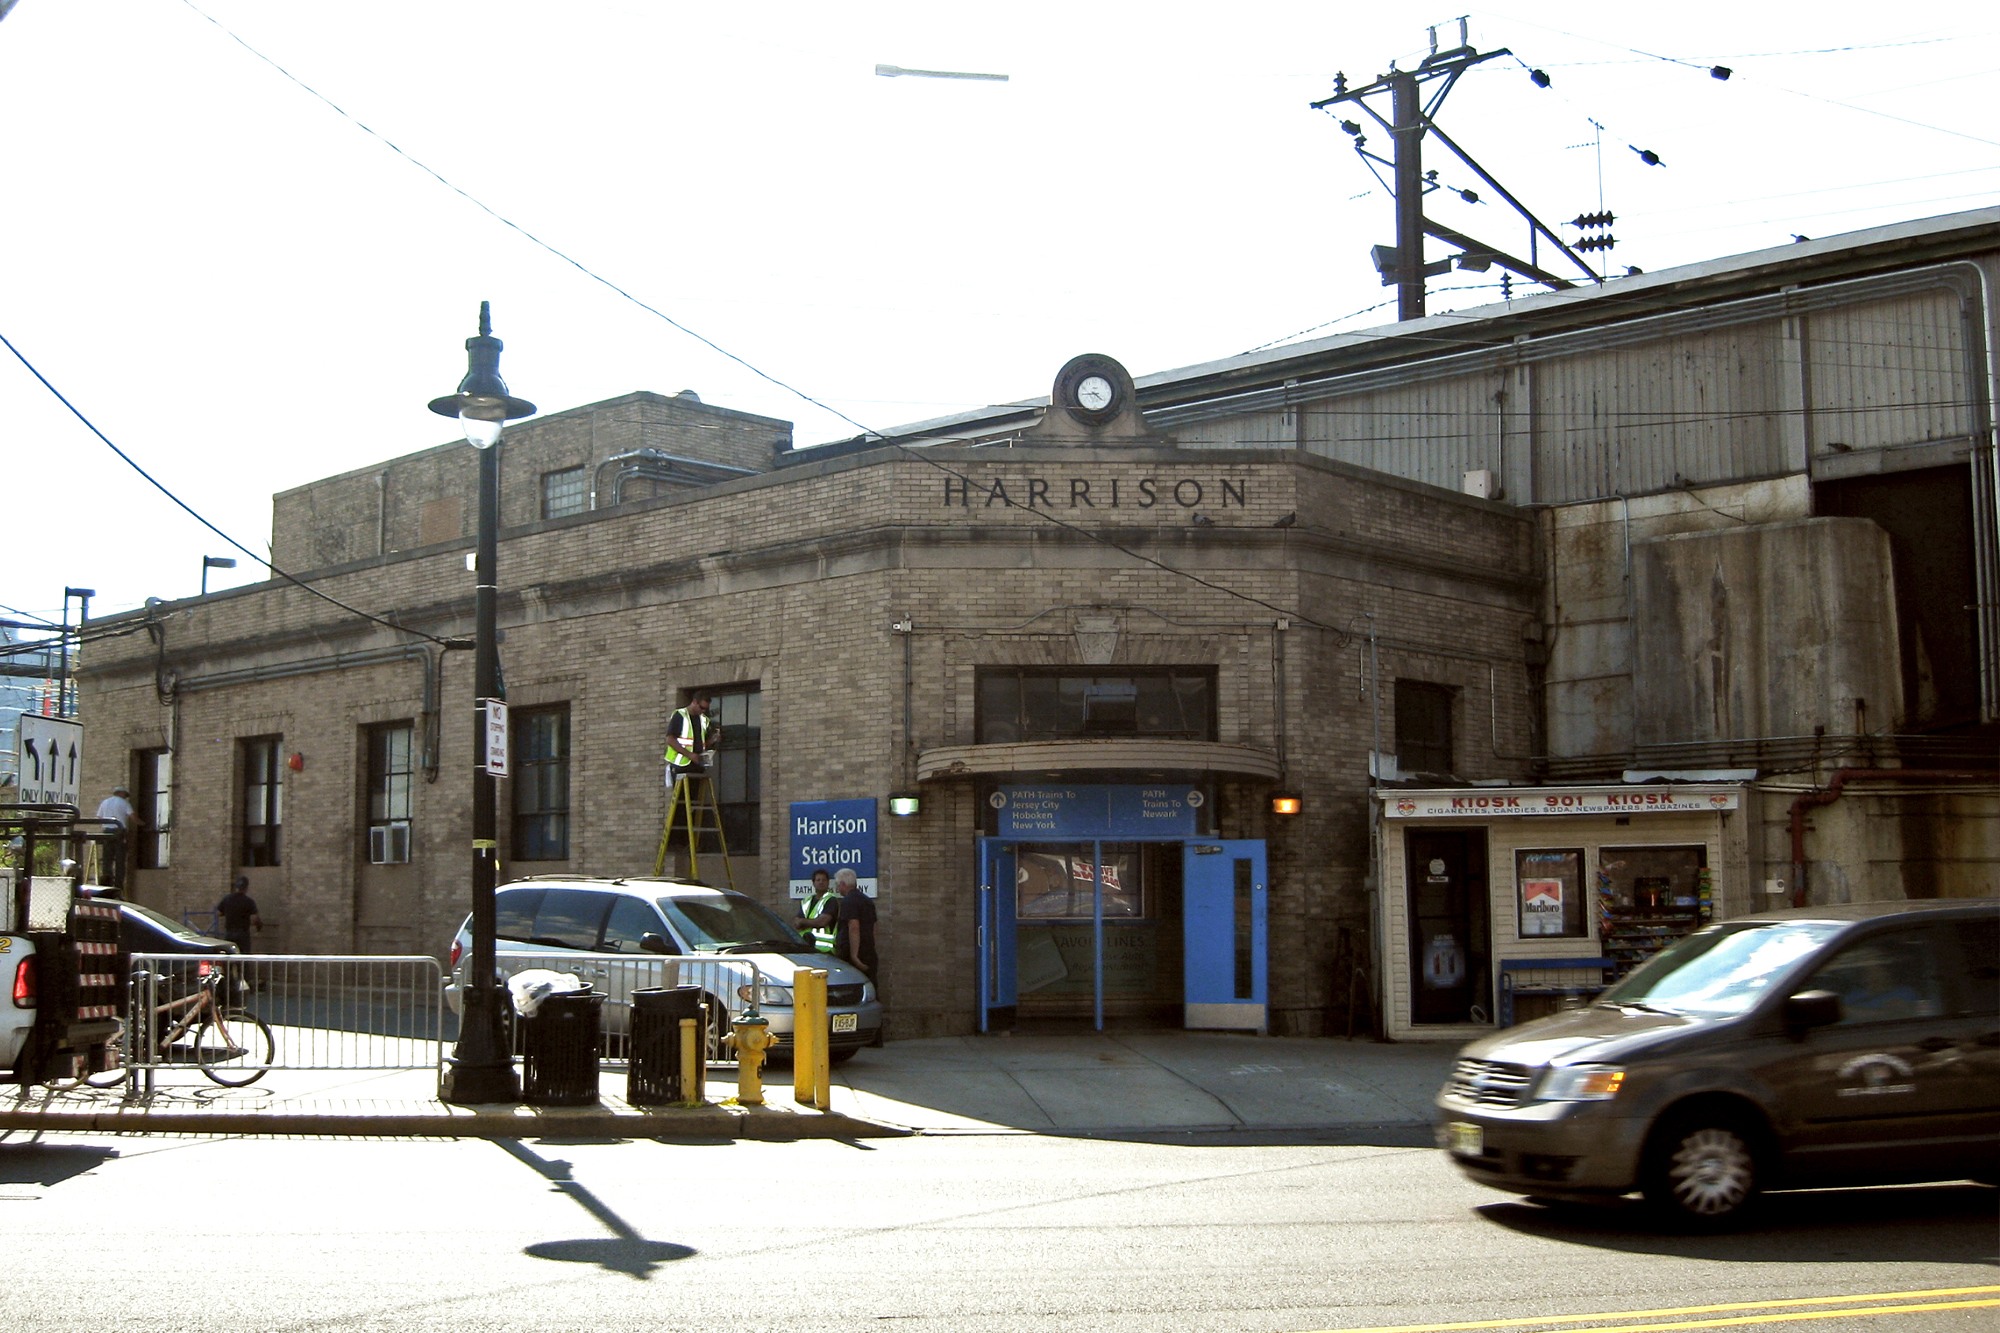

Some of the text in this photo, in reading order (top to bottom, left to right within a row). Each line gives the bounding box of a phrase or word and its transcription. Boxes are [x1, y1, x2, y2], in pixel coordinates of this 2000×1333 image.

[943, 477, 1246, 508] HARRISON
[493, 706, 501, 720] NO
[21, 788, 78, 804] ONLY ONLY ONLY
[1012, 791, 1076, 799] PATH Trains To
[1142, 790, 1166, 798] PATH
[1143, 800, 1181, 808] Trains To
[1452, 793, 1674, 808] KIOSK 901 KIOSK
[1012, 801, 1060, 810] Jersey City
[1575, 804, 1643, 812] NEWSPAPERS,
[1012, 811, 1053, 819] Hoboken
[1142, 810, 1177, 818] Newark
[797, 814, 867, 835] Harrison
[1012, 821, 1056, 829] New York
[802, 844, 861, 865] Station
[795, 885, 813, 894] PATH
[1525, 900, 1560, 913] Marlboro
[1060, 935, 1093, 948] AVOI
